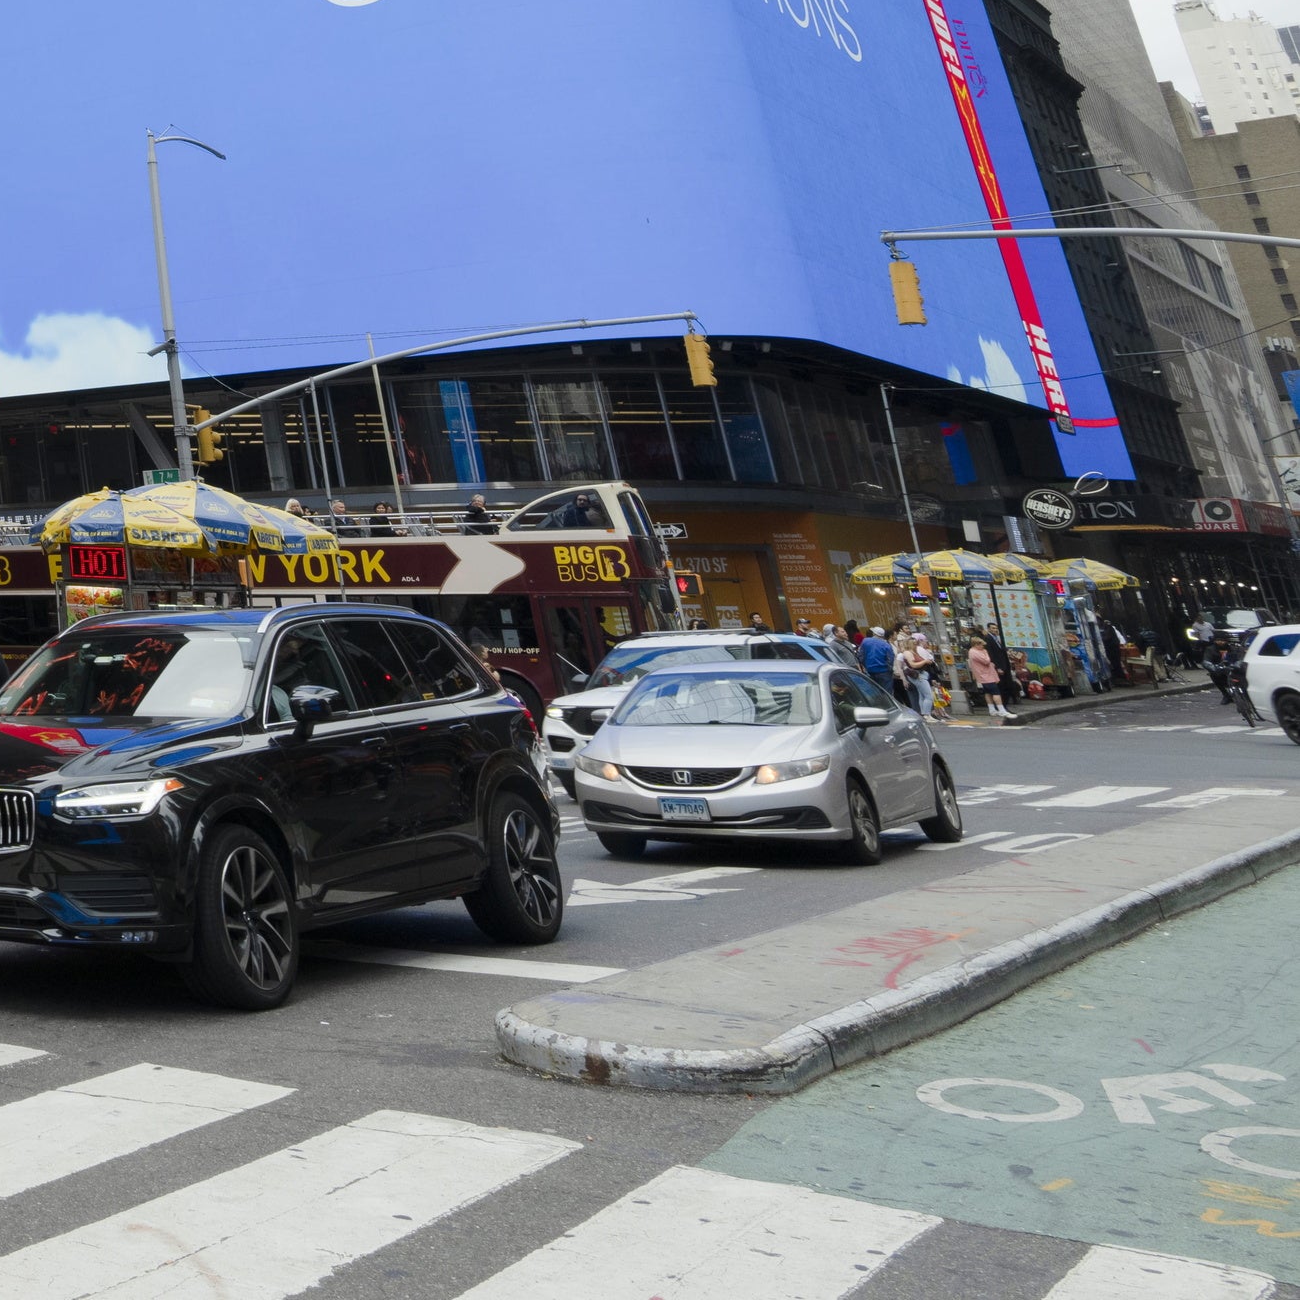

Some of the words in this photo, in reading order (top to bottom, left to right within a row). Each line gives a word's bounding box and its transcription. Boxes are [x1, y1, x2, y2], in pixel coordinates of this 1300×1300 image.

[1026, 499, 1072, 520] HERSHEY'S
[131, 528, 199, 544] SABRETT
[257, 531, 281, 546] ABRETT
[311, 539, 338, 550] ABRETT
[80, 549, 120, 575] HOT
[553, 546, 595, 565] BIG
[282, 549, 391, 583] YORK
[713, 557, 728, 573] SF
[557, 565, 599, 582] BUS
[507, 647, 540, 655] HOP-OFF
[663, 802, 705, 815] AM-77049
